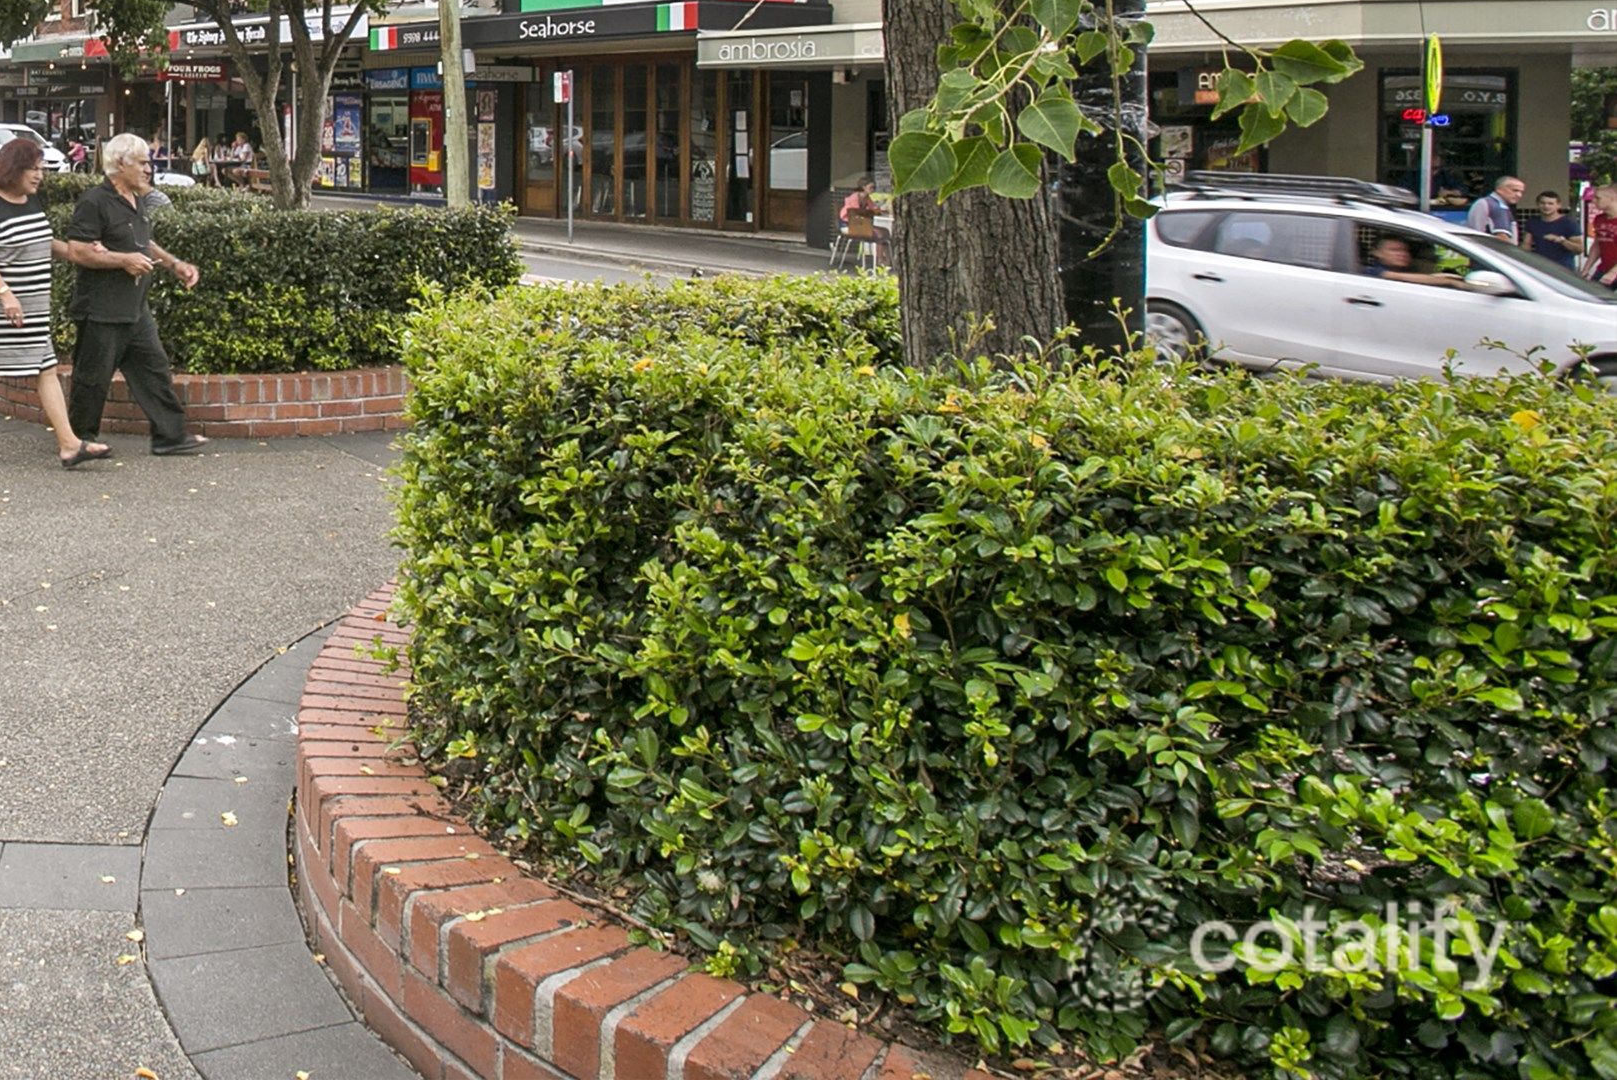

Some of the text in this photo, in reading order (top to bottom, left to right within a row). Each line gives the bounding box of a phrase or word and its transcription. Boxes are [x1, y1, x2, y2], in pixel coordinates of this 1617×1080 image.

[519, 16, 596, 39] Seahorse
[719, 36, 816, 60] ambrosia
[192, 65, 222, 75] FROGS
